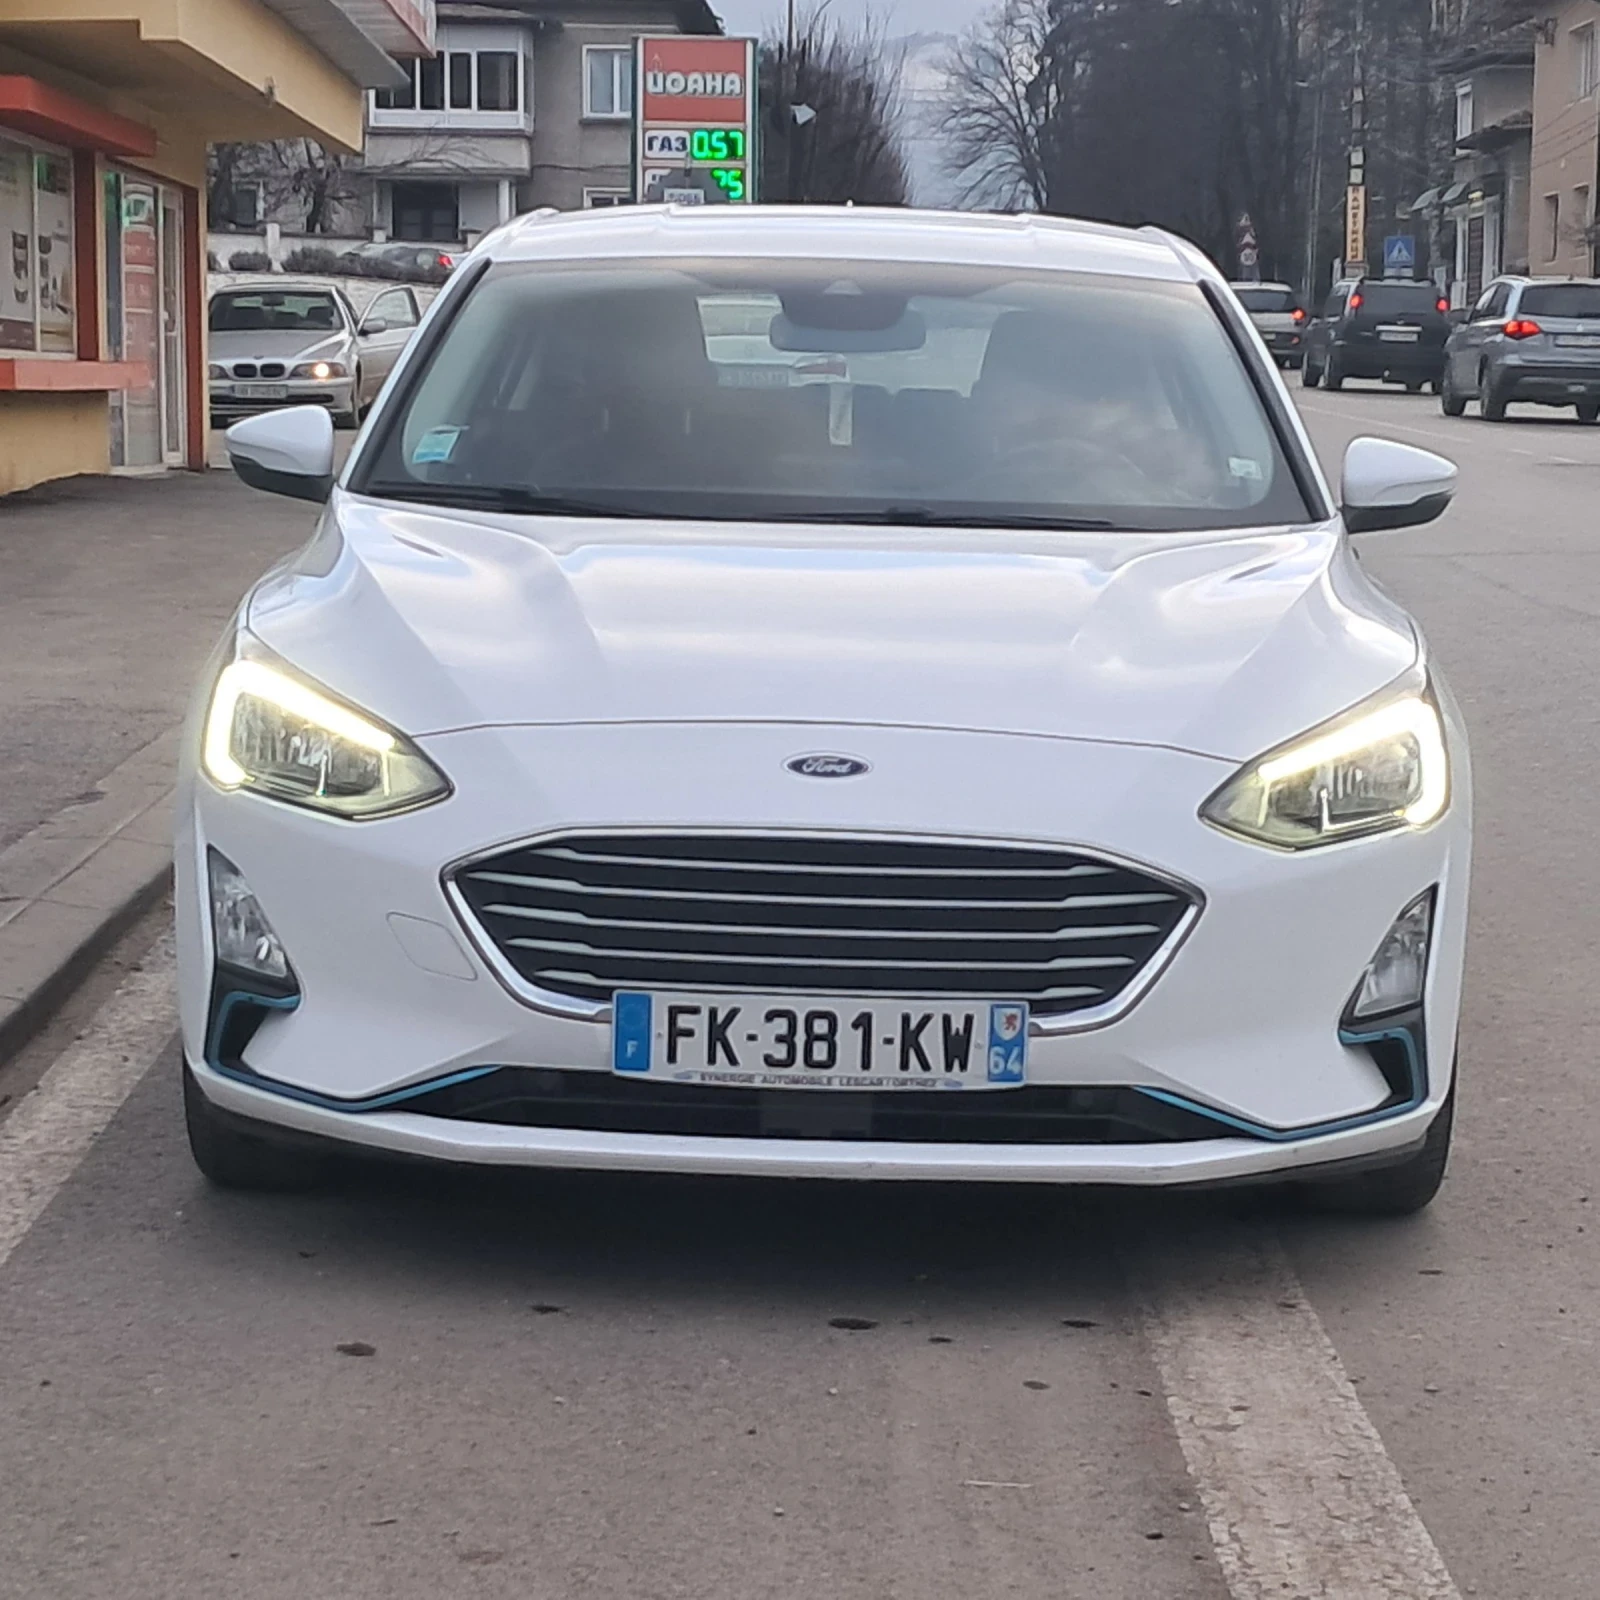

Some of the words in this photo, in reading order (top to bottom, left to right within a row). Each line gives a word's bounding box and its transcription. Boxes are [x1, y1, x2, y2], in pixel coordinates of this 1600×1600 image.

[647, 136, 687, 151] ГАЗ
[802, 758, 852, 773] Ford
[666, 1005, 975, 1073] FK-381-KW
[627, 1040, 638, 1057] F
[990, 1045, 1022, 1075] 64
[761, 1074, 833, 1087] AUTOMOBILE
